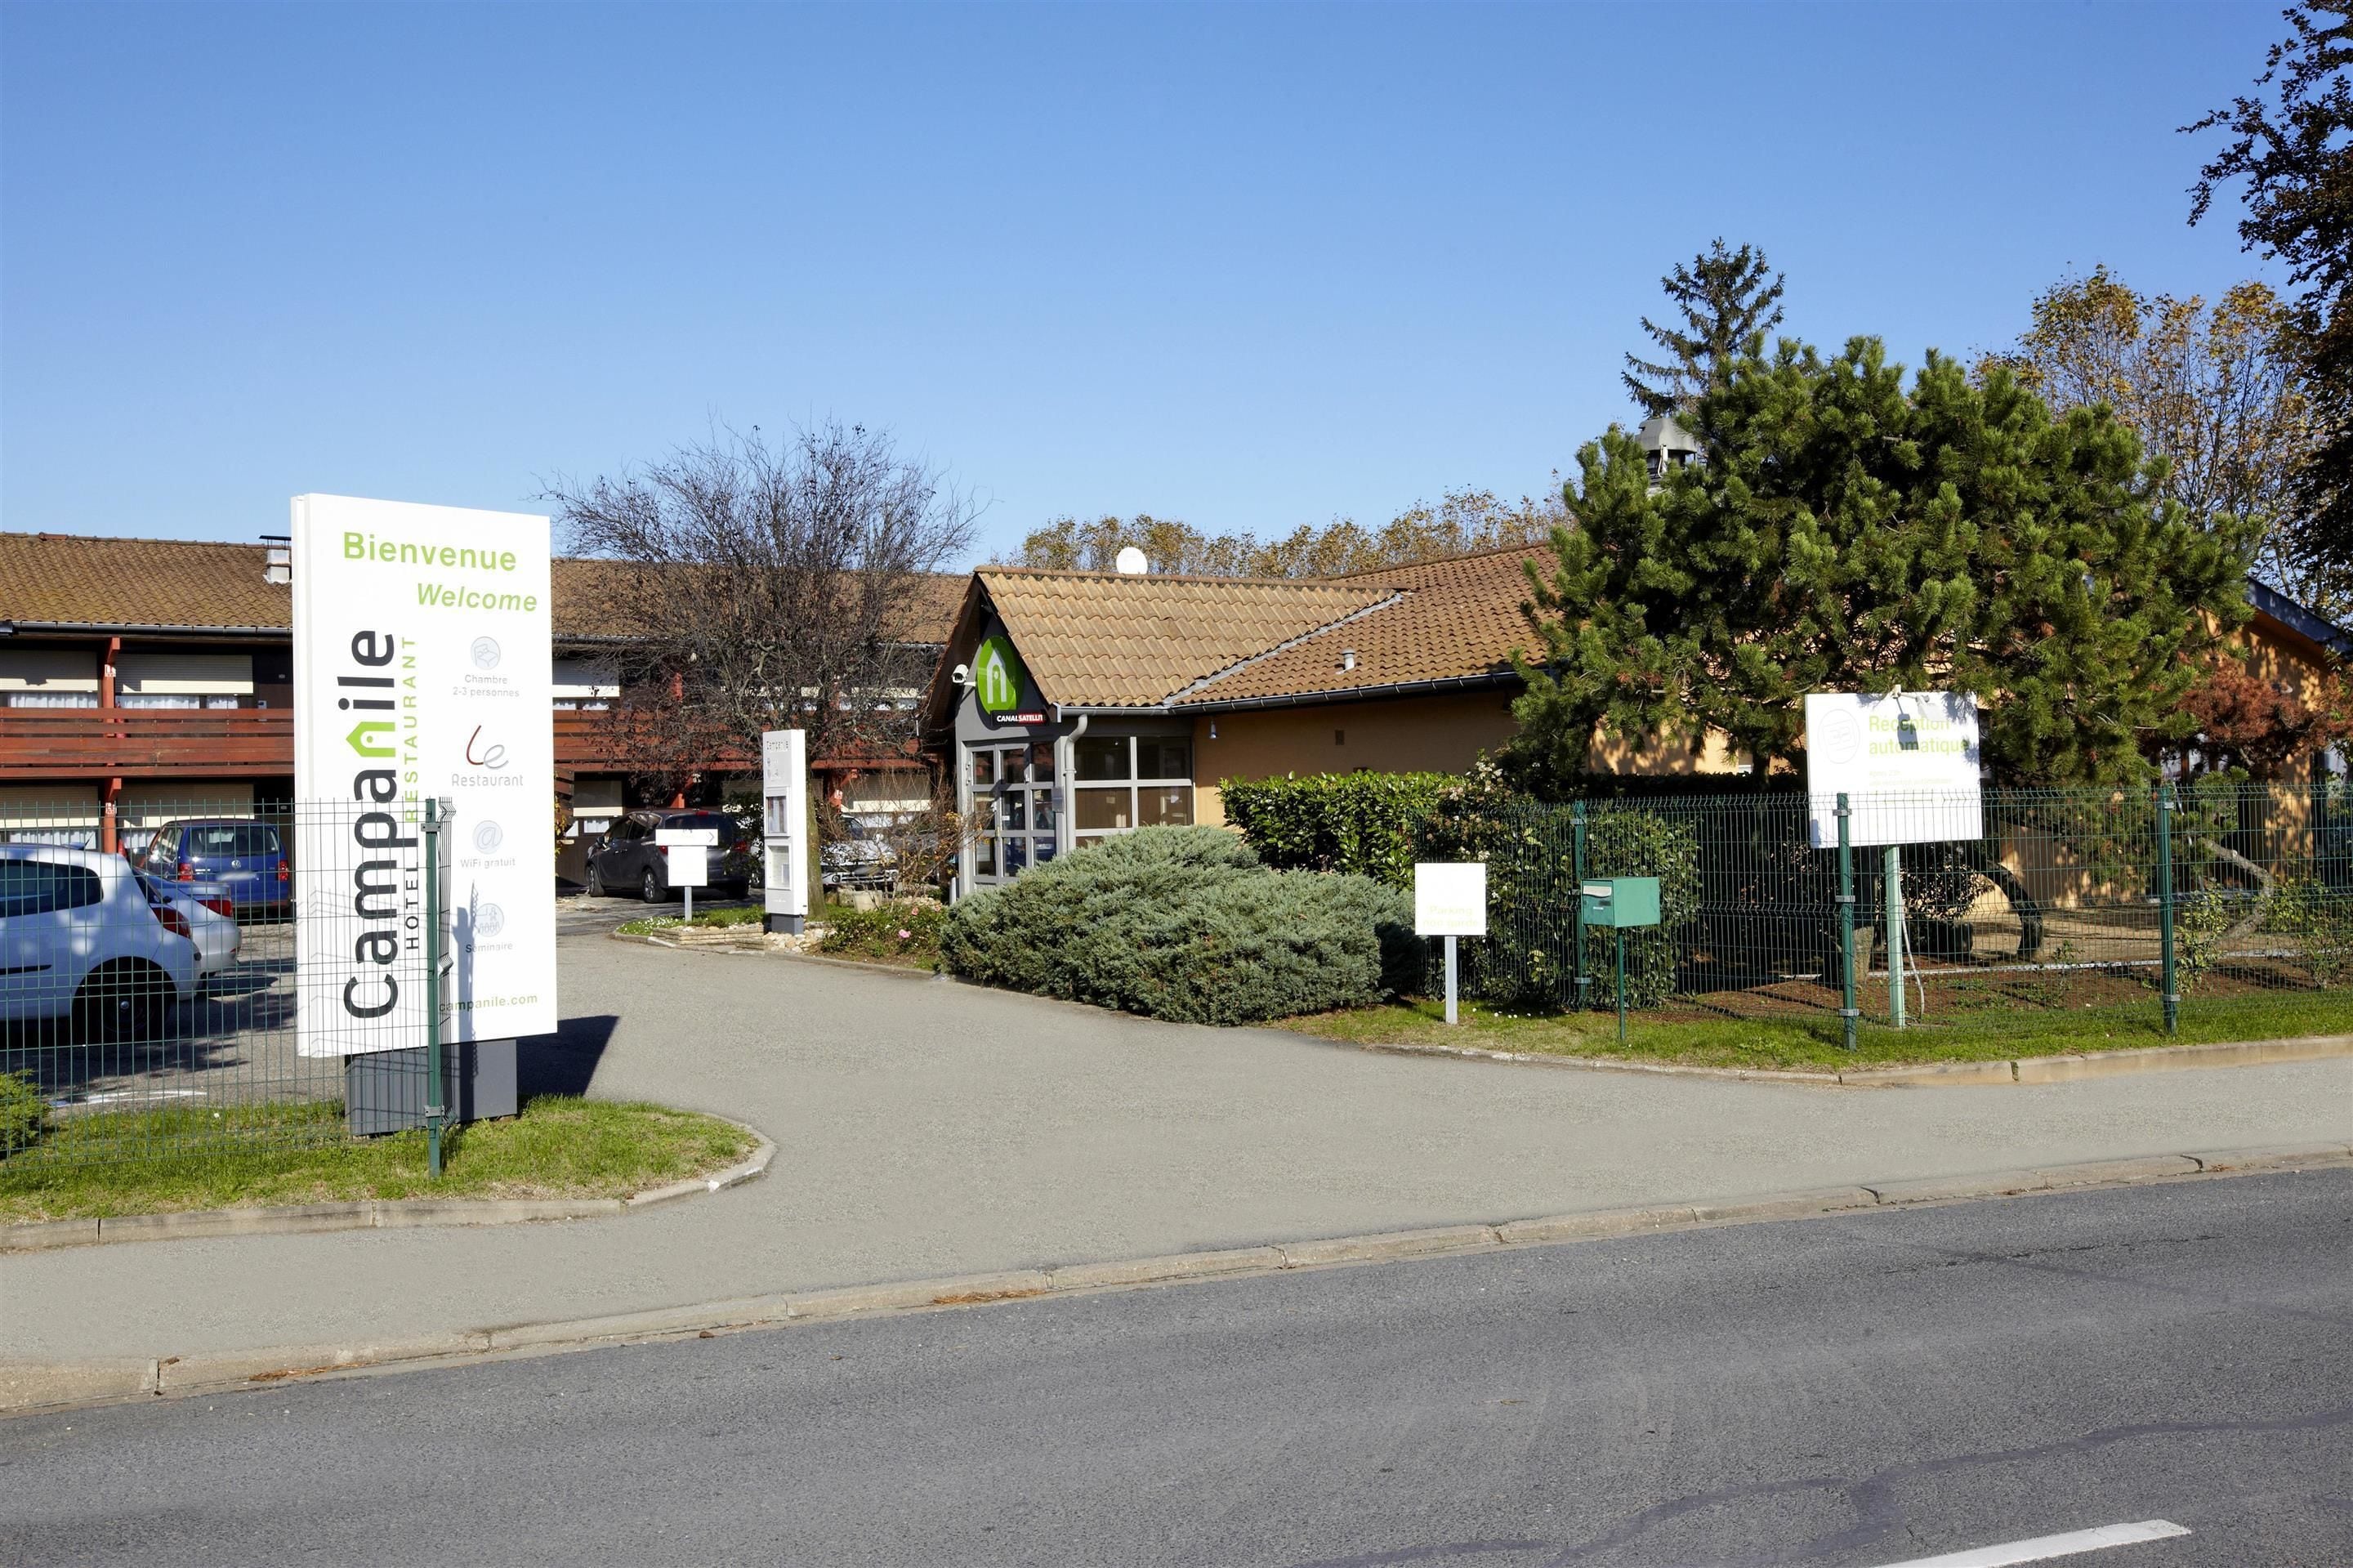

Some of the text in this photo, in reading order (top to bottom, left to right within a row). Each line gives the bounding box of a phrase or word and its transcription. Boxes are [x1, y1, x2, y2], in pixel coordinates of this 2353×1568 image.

[343, 531, 517, 572] Bienvenue
[417, 583, 538, 612] Welcome
[464, 674, 508, 685] Chambre
[452, 686, 520, 698] 2-3 personnes
[996, 713, 1046, 722] CANALSATELLIT
[1869, 738, 1969, 756] automatique
[451, 773, 524, 787] Restaurant
[401, 637, 419, 950] HOTEL RESTAURANT
[459, 857, 516, 869] WiFi gratuit
[1429, 905, 1473, 916] Parking
[439, 994, 538, 1012] campanile.com
